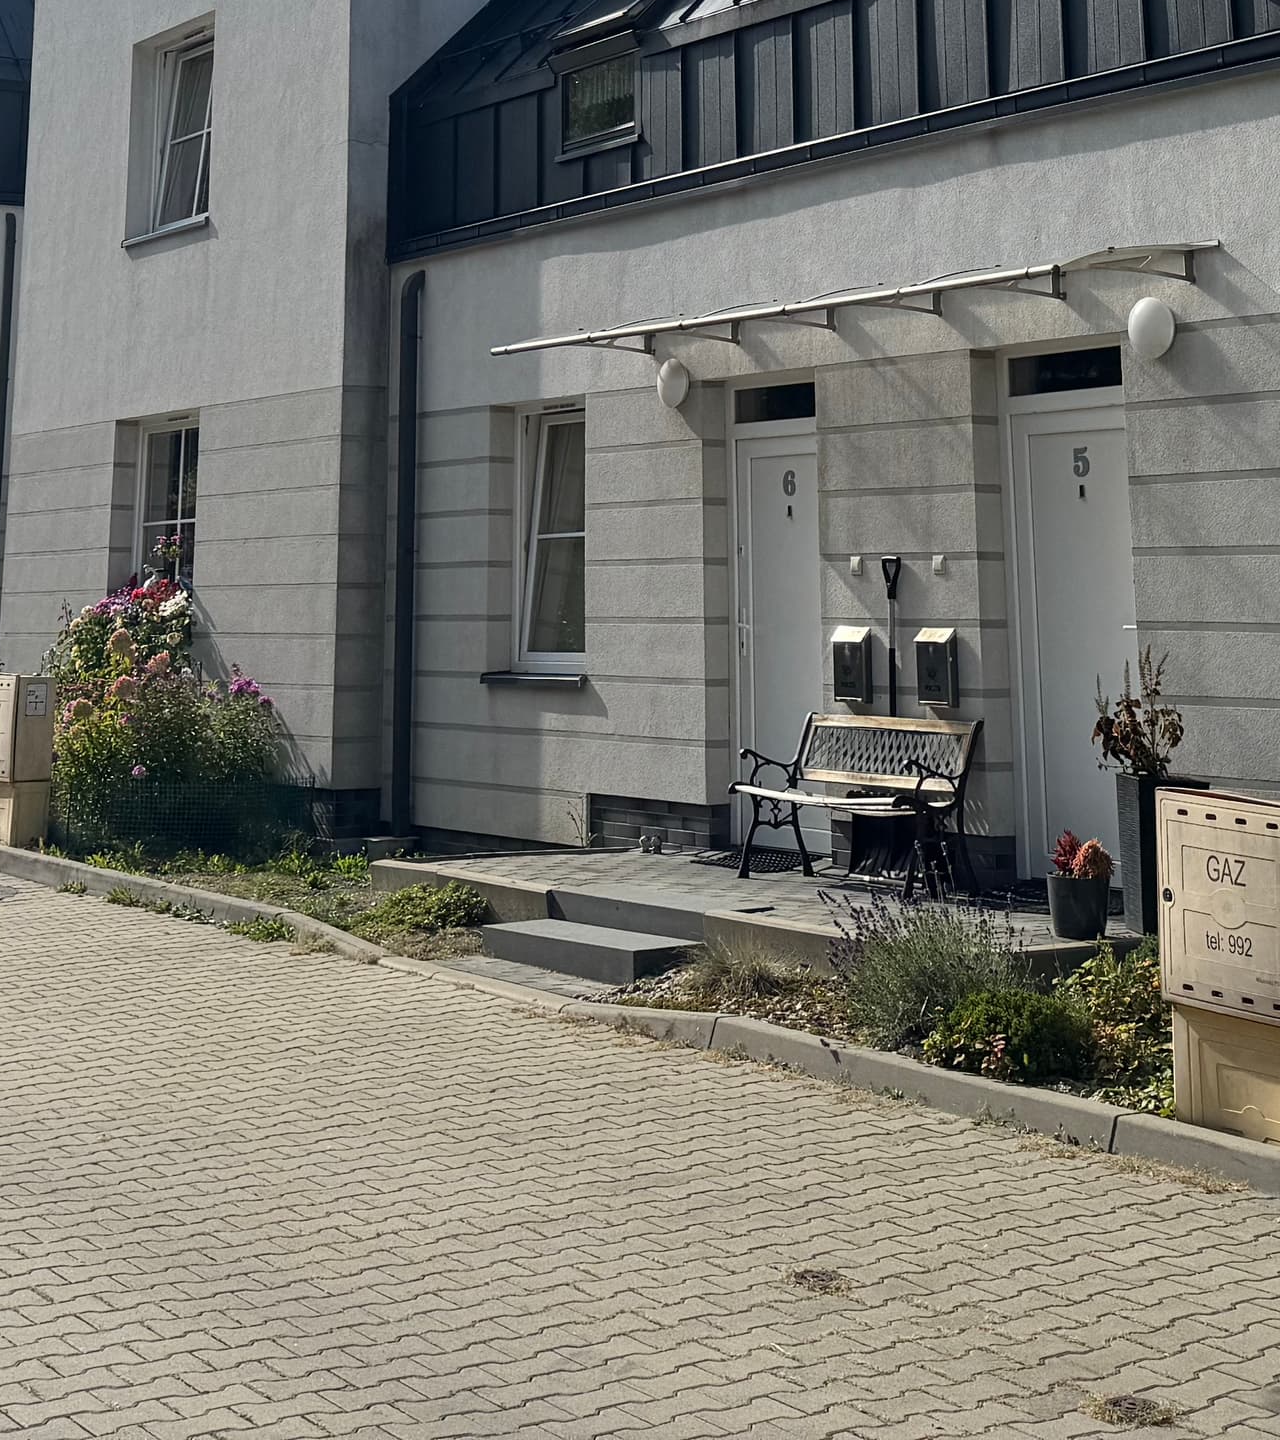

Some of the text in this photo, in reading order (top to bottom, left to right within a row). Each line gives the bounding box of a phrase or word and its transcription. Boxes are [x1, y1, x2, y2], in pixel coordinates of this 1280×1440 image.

[1073, 446, 1090, 478] 5
[783, 470, 796, 497] 6
[1206, 855, 1247, 887] GAZ
[1205, 930, 1253, 958] tel: 992
